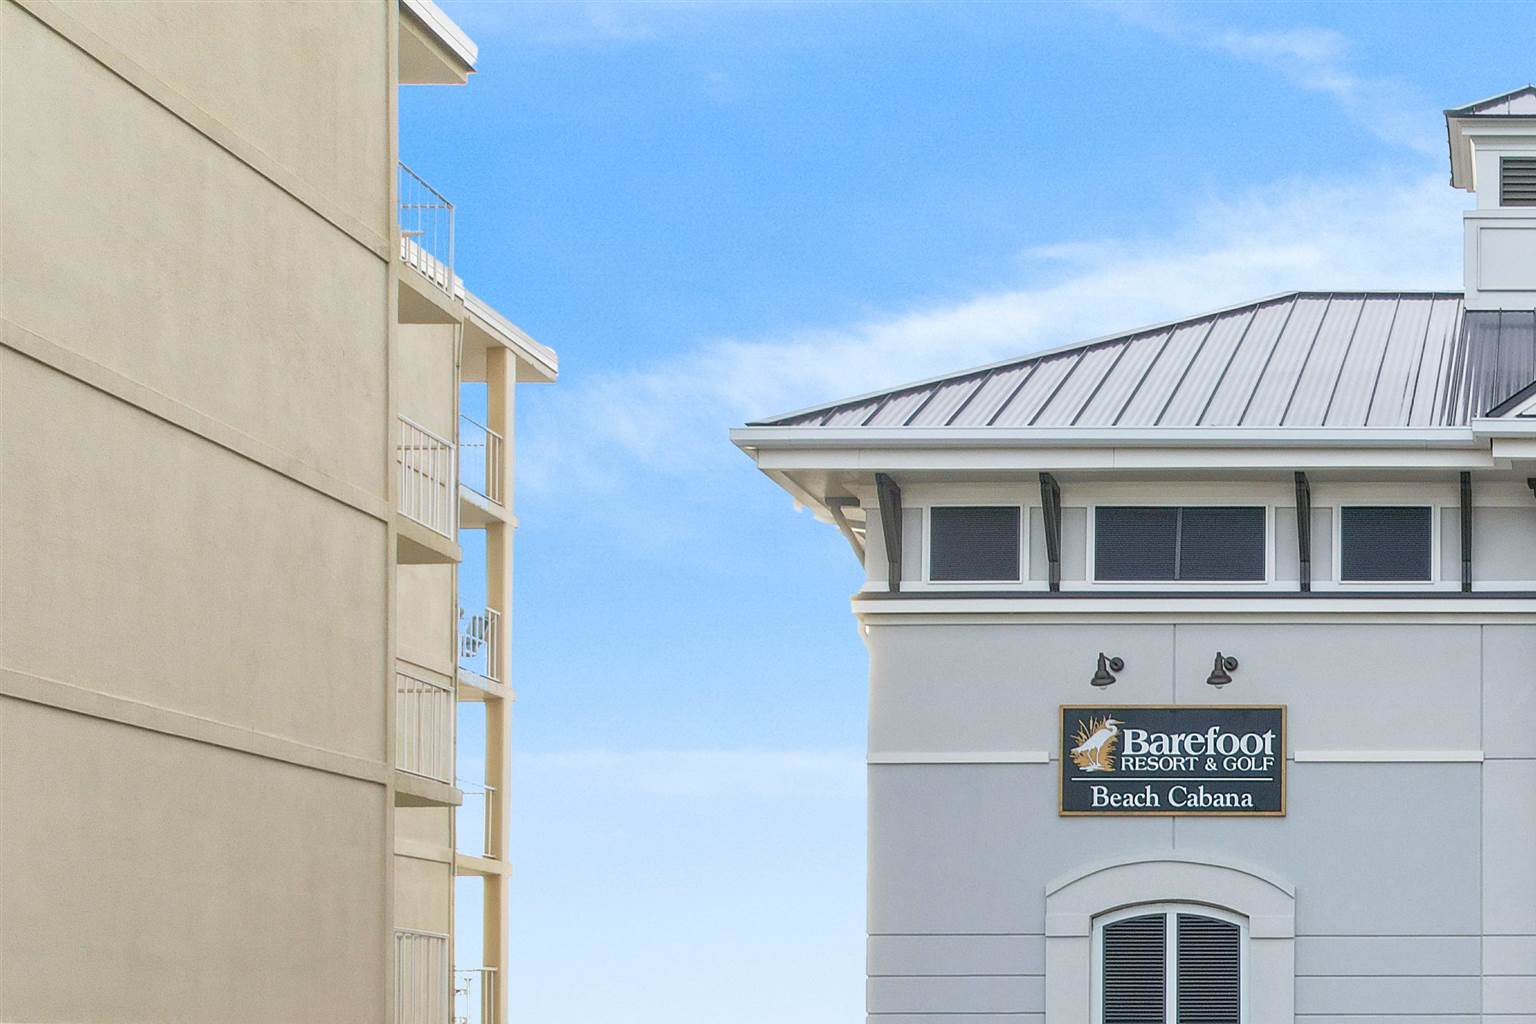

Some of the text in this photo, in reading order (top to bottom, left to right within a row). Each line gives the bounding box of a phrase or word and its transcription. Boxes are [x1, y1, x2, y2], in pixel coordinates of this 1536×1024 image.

[1121, 726, 1276, 756] Barefoot
[1120, 757, 1275, 771] RESORT & GOLF
[1090, 785, 1254, 807] Beach Cabana
